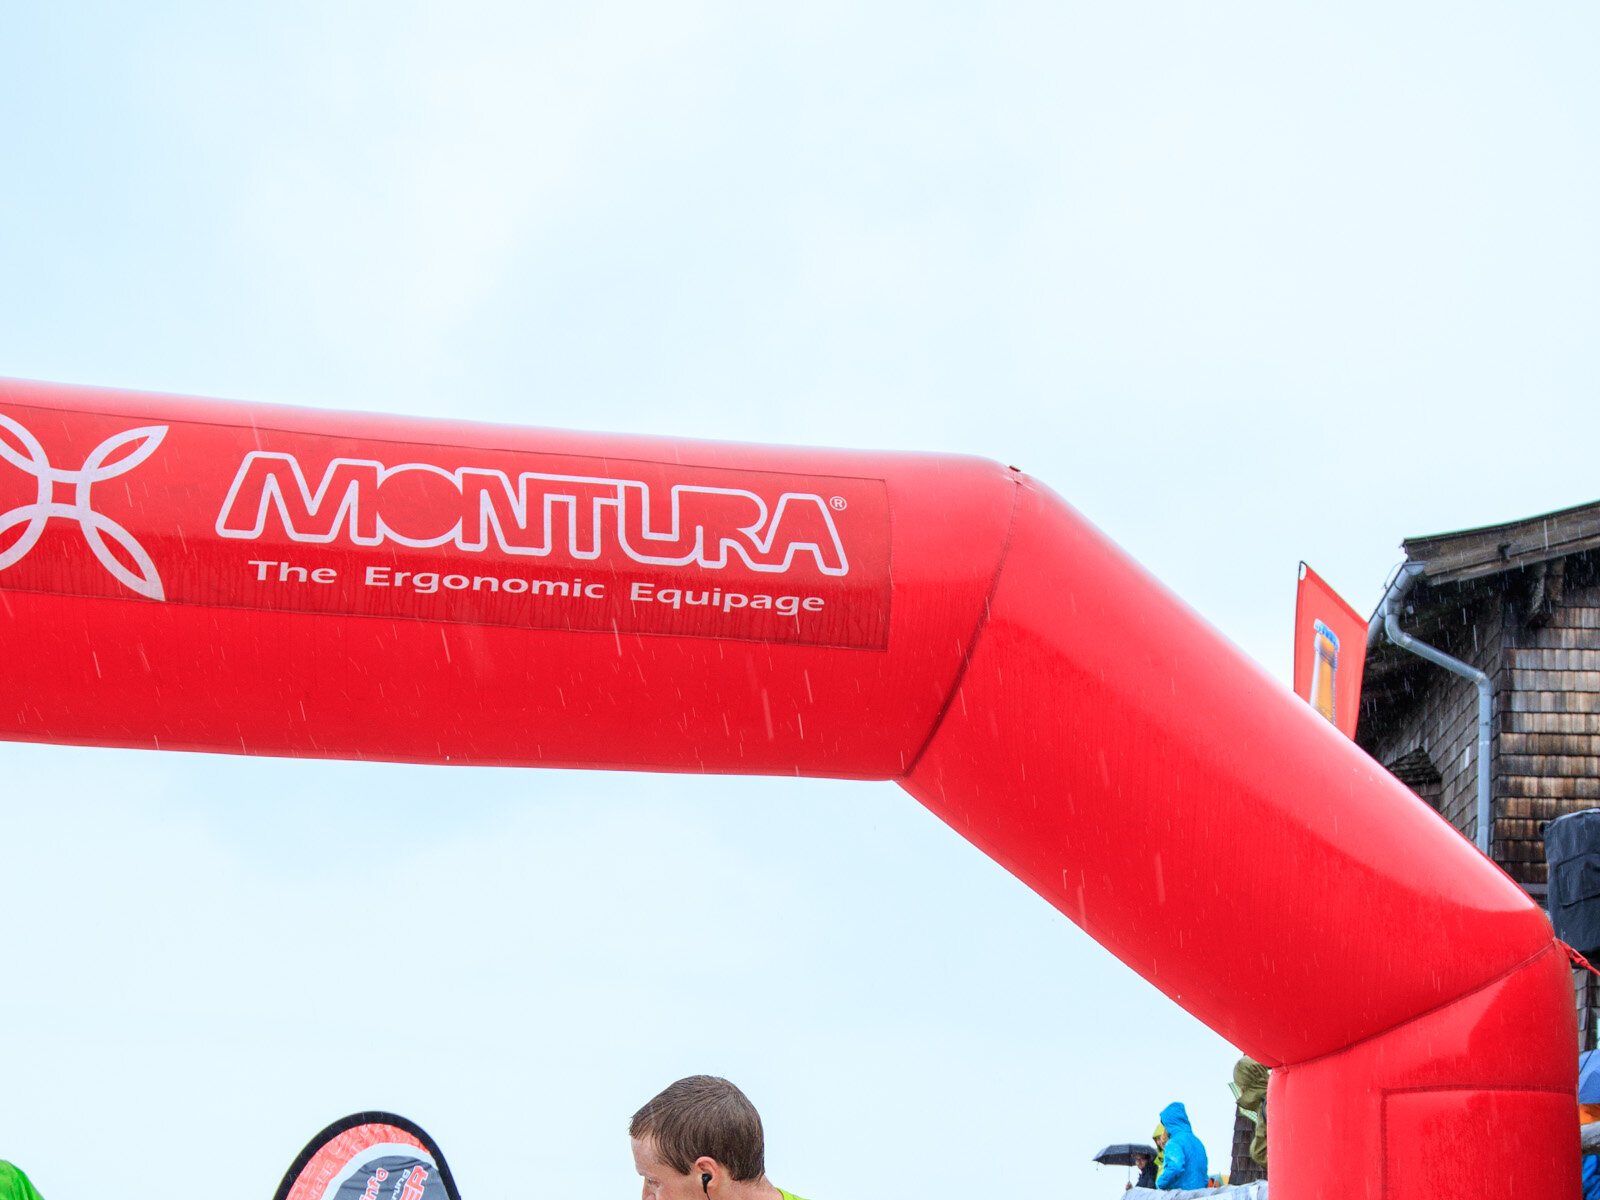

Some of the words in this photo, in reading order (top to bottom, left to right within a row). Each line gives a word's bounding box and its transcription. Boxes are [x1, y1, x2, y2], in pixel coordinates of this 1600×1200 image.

[248, 560, 338, 586] The
[365, 565, 606, 600] Ergonomic
[630, 582, 825, 615] Equipage
